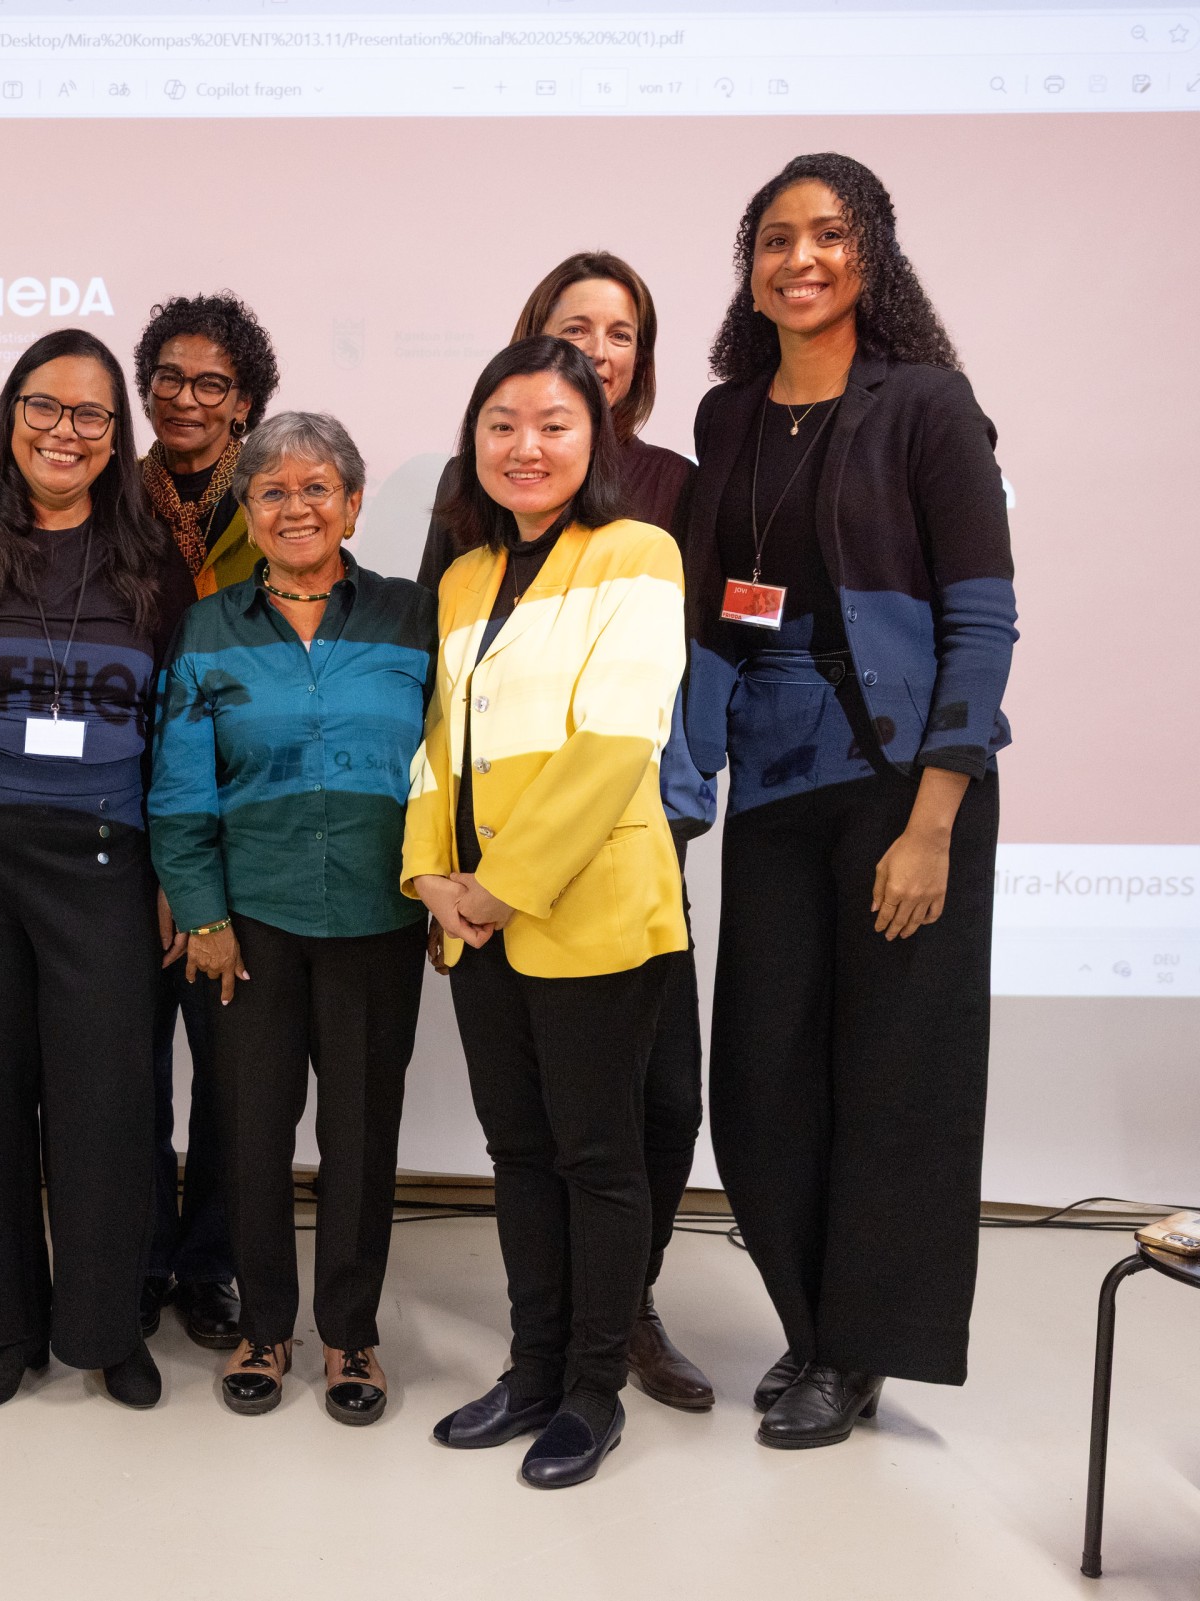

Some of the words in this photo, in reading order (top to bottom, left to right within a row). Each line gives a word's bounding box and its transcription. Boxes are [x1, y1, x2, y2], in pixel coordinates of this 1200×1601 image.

[195, 81, 250, 100] Copilot
[253, 81, 302, 100] fragen
[596, 81, 612, 94] 16
[638, 83, 664, 94] von
[667, 81, 683, 94] 17
[1152, 953, 1181, 967] DEU
